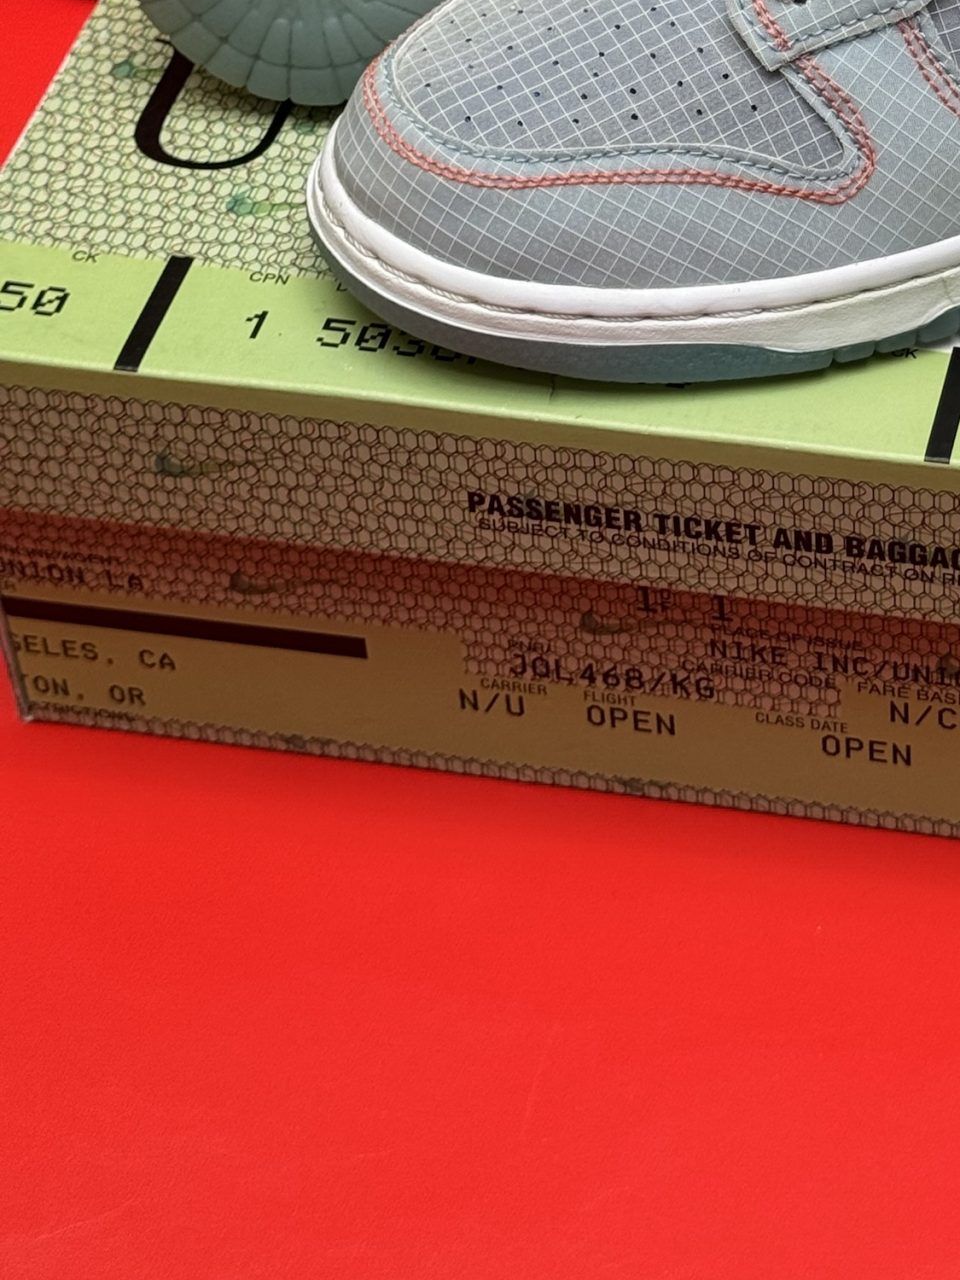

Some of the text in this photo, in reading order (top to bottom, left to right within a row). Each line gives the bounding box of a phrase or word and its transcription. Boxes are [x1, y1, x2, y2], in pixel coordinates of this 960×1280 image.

[72, 250, 100, 263] CK
[249, 271, 291, 286] CPN
[245, 309, 270, 340] 1
[467, 491, 643, 534] PASSENGER
[652, 514, 761, 546] TICKET
[773, 527, 834, 555] AND
[478, 518, 572, 540] SUBJECT
[578, 529, 605, 544] TO
[611, 532, 740, 561] CONDITIONS
[747, 548, 775, 564] OF
[782, 552, 898, 579] CONTRACT
[903, 567, 935, 584] ON
[139, 649, 177, 670] CA
[709, 638, 787, 667] NIKE
[681, 658, 836, 689] CARRIER CODE
[108, 684, 147, 706] OR
[480, 676, 636, 707] CARRIER FLIGHT
[857, 680, 910, 700] FARE
[458, 687, 676, 737] N/U OPEN
[754, 711, 849, 734] CLASS DATE
[821, 733, 914, 767] OPEN
